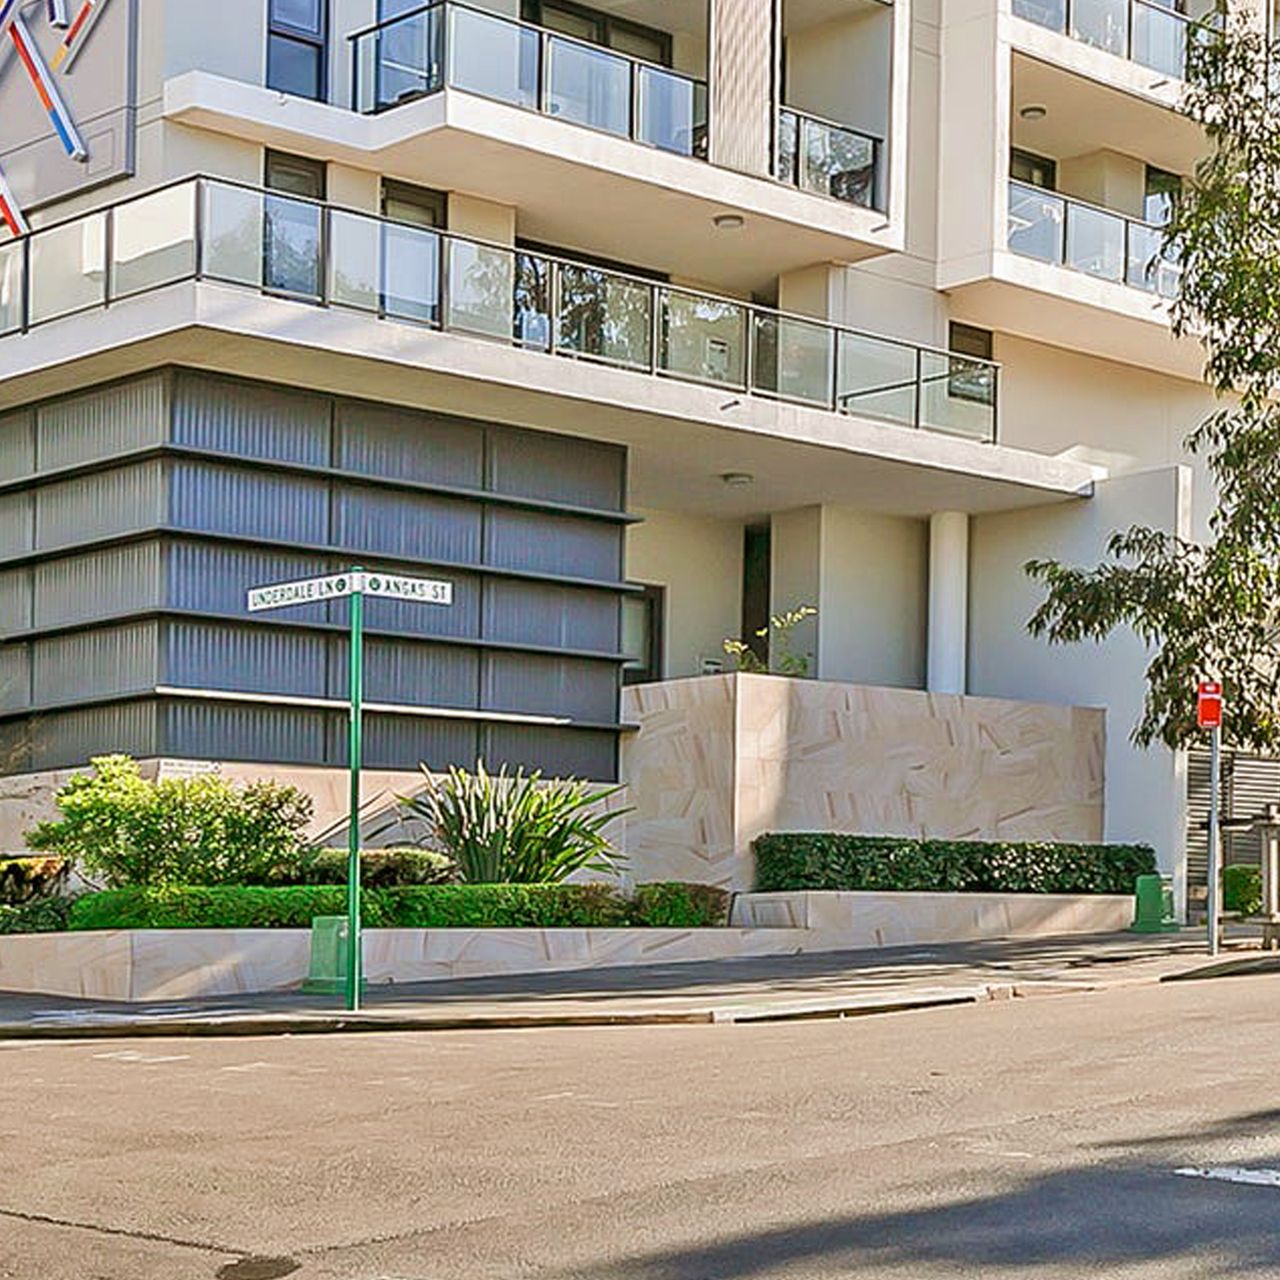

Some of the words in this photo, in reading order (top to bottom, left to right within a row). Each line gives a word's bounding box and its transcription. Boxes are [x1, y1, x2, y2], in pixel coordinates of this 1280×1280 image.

[318, 580, 334, 596] LN
[384, 579, 426, 597] ANGAS
[432, 584, 446, 600] ST
